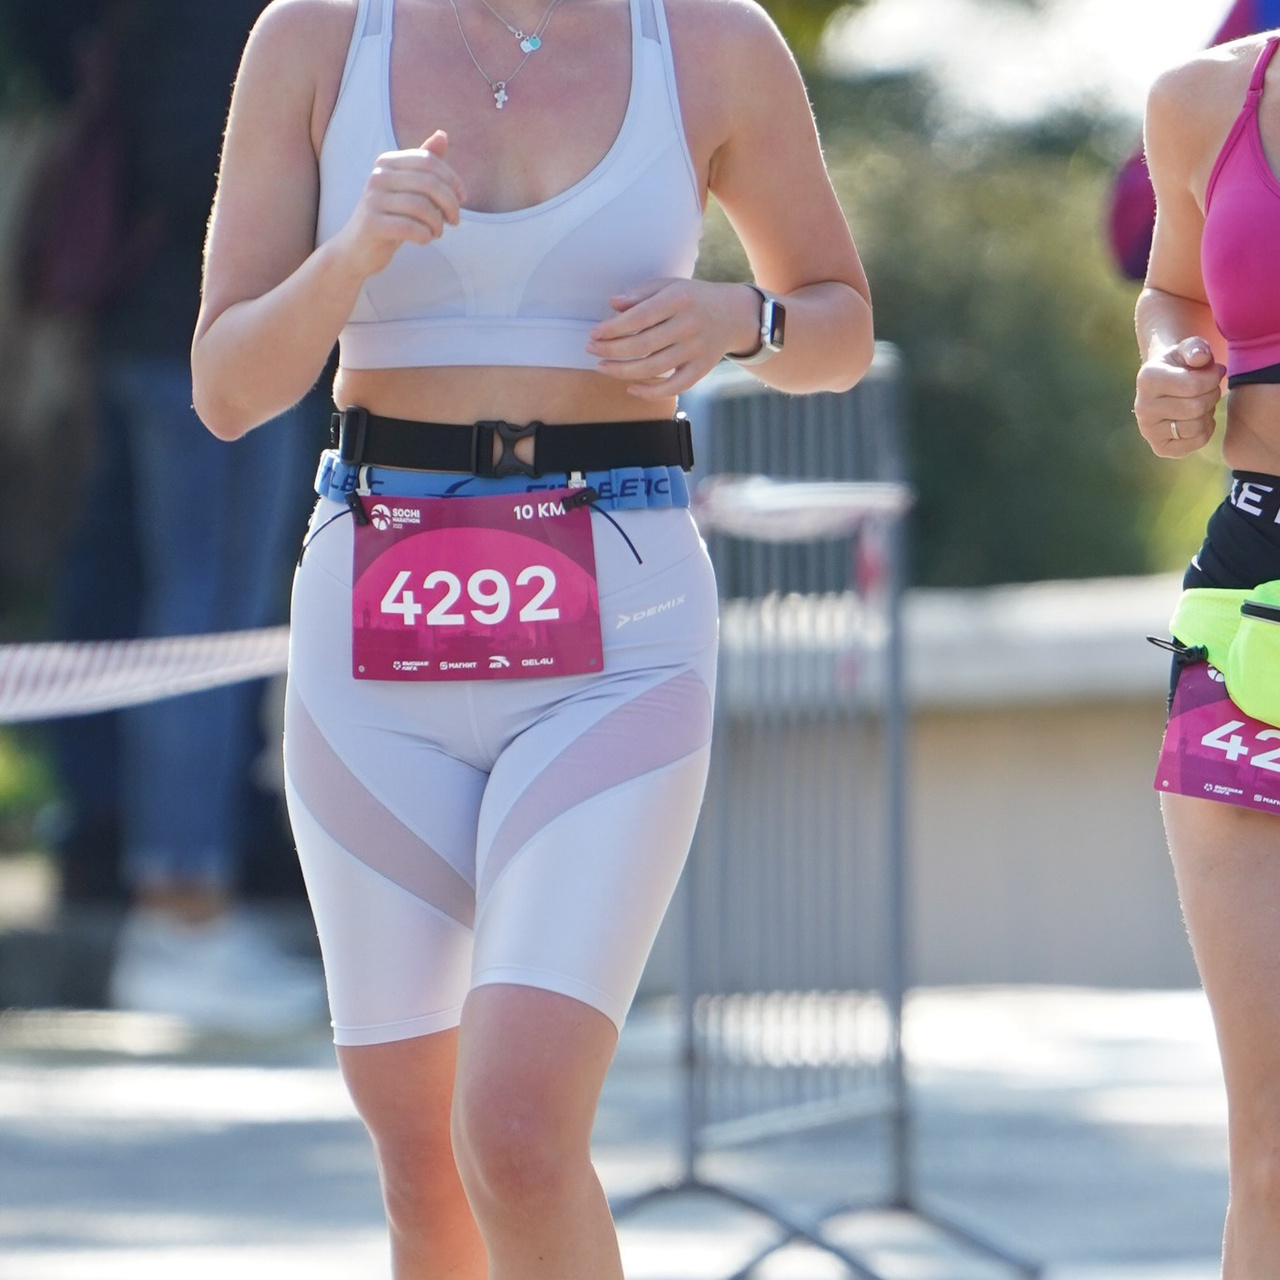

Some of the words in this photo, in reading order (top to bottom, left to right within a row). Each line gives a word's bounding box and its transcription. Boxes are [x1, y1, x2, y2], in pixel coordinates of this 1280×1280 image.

[392, 508, 420, 518] SOCHI
[513, 504, 534, 520] 10
[538, 502, 566, 518] KM
[380, 565, 560, 626] 4292
[633, 595, 686, 622] DEMIX
[448, 661, 477, 669] МАГНИТ
